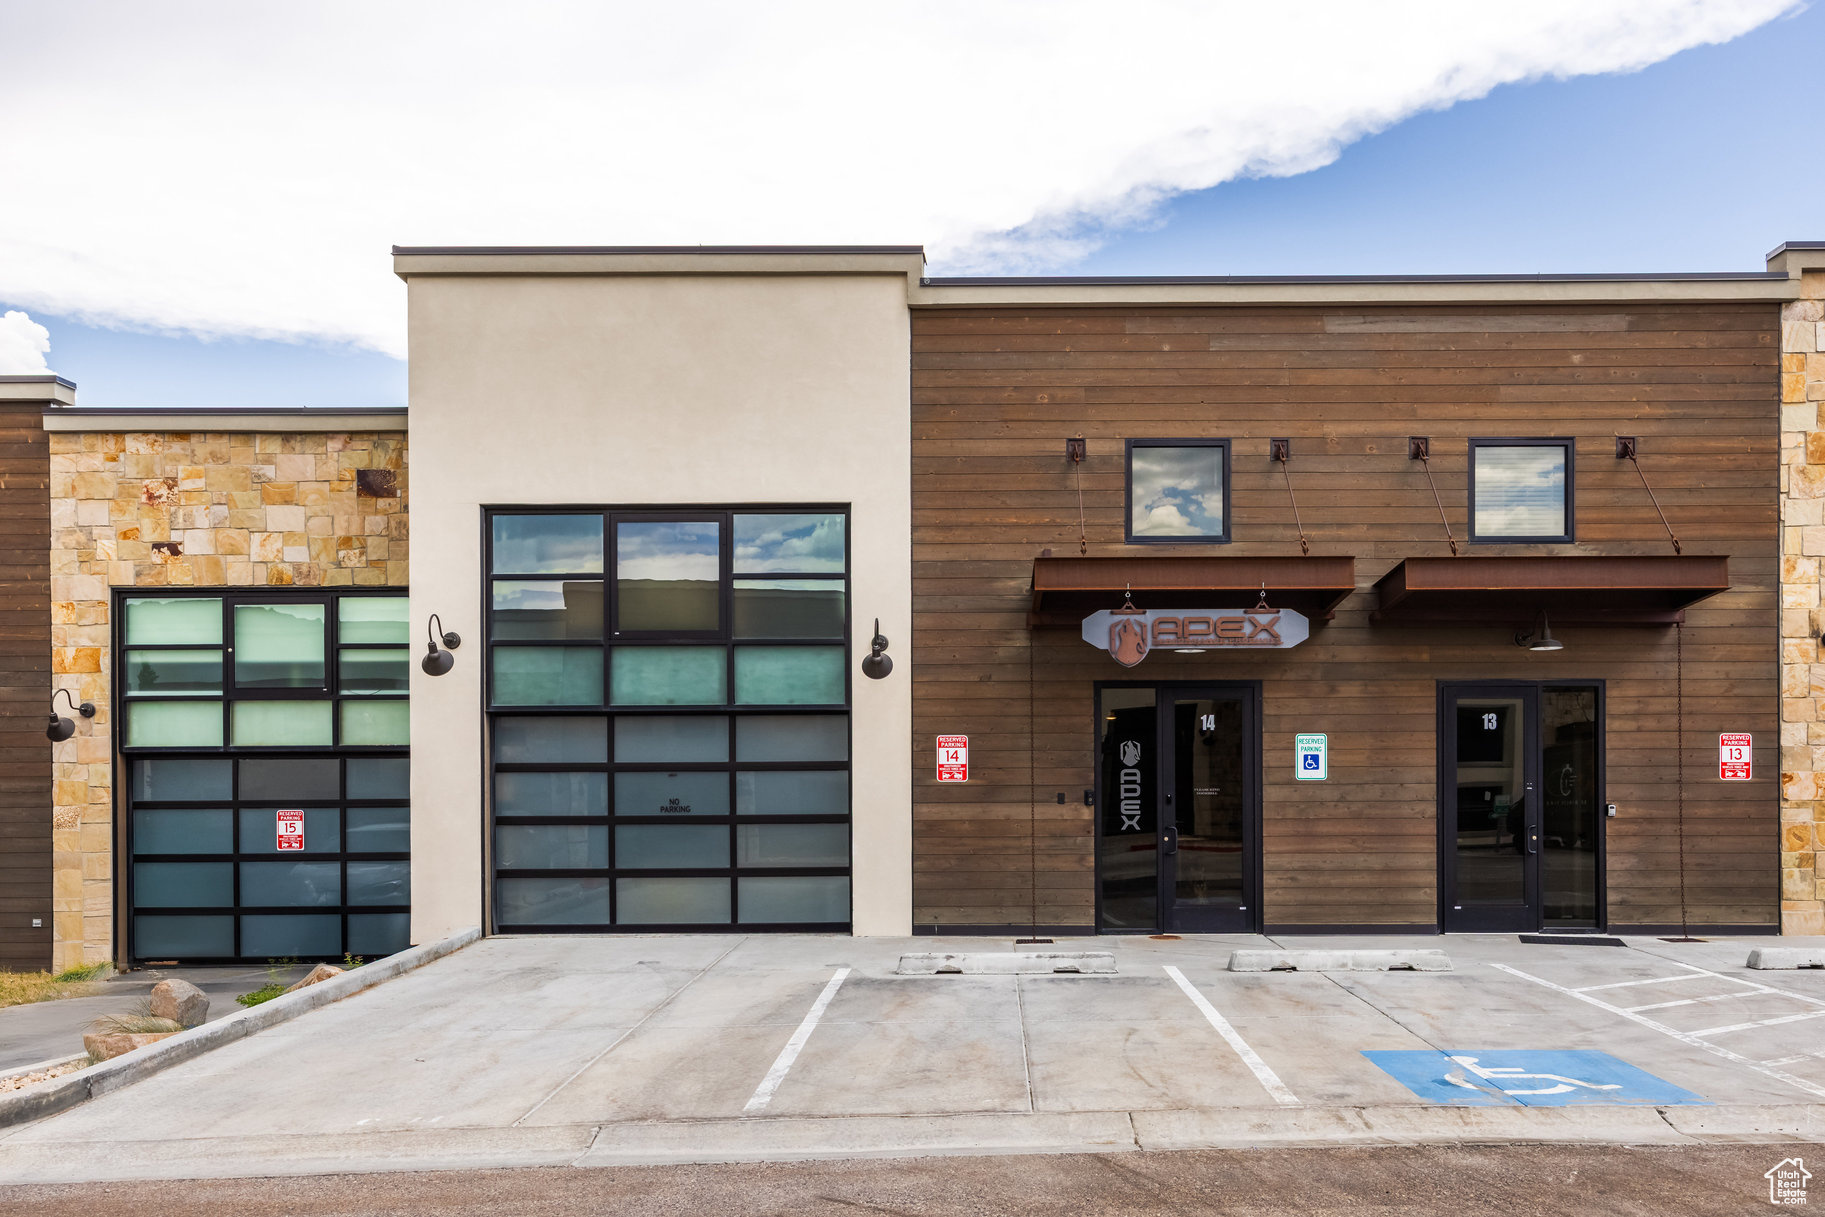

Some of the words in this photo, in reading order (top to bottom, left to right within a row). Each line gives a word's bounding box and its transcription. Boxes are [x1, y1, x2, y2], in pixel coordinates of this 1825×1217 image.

[1152, 616, 1281, 638] APEX
[1200, 715, 1215, 730] 14
[1482, 713, 1497, 729] 13
[946, 750, 959, 762] 14
[1729, 748, 1742, 760] 13
[1120, 769, 1140, 830] APEX
[285, 822, 296, 833] 15
